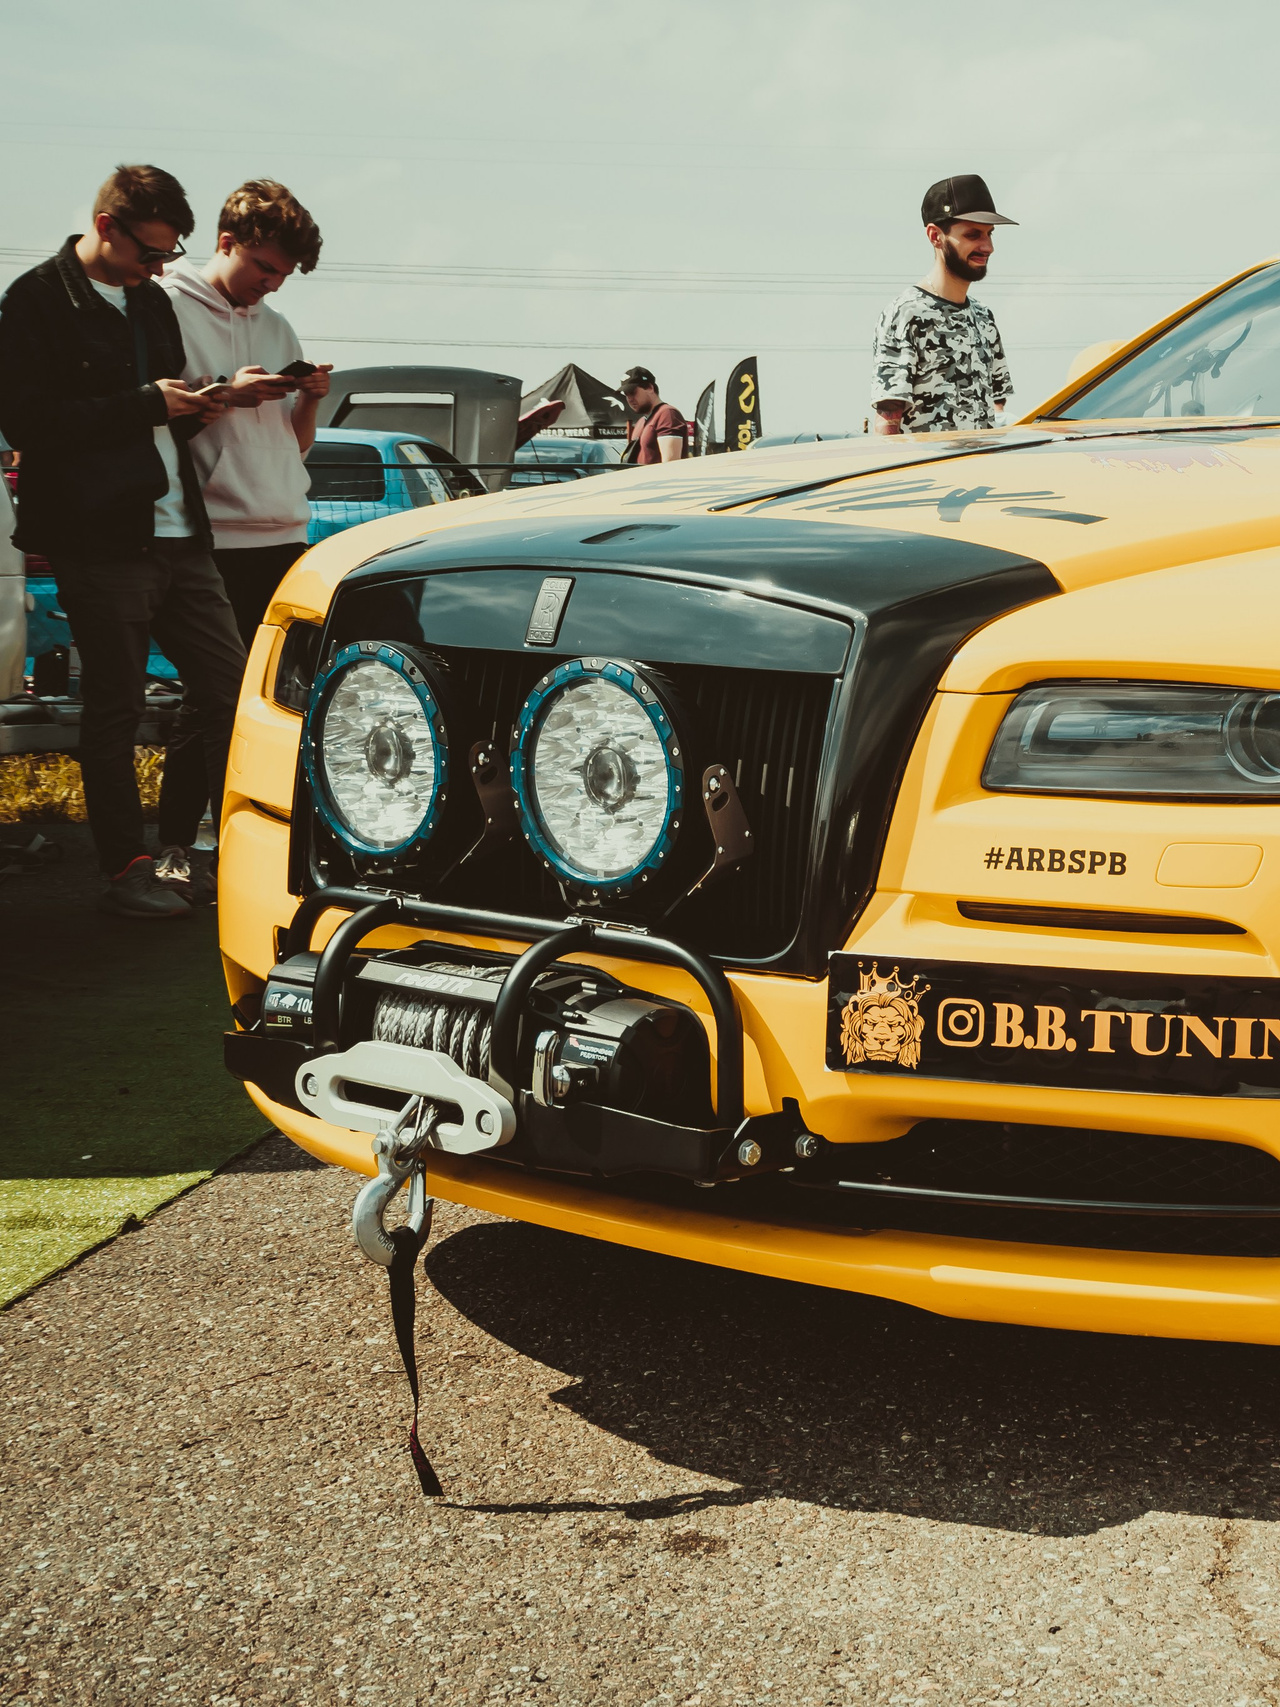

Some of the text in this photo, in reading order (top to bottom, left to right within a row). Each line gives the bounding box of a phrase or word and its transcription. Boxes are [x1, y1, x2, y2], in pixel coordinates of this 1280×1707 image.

[565, 427, 591, 437] WEAR
[984, 846, 1127, 876] #ARBSPB
[394, 971, 474, 995] redBTR
